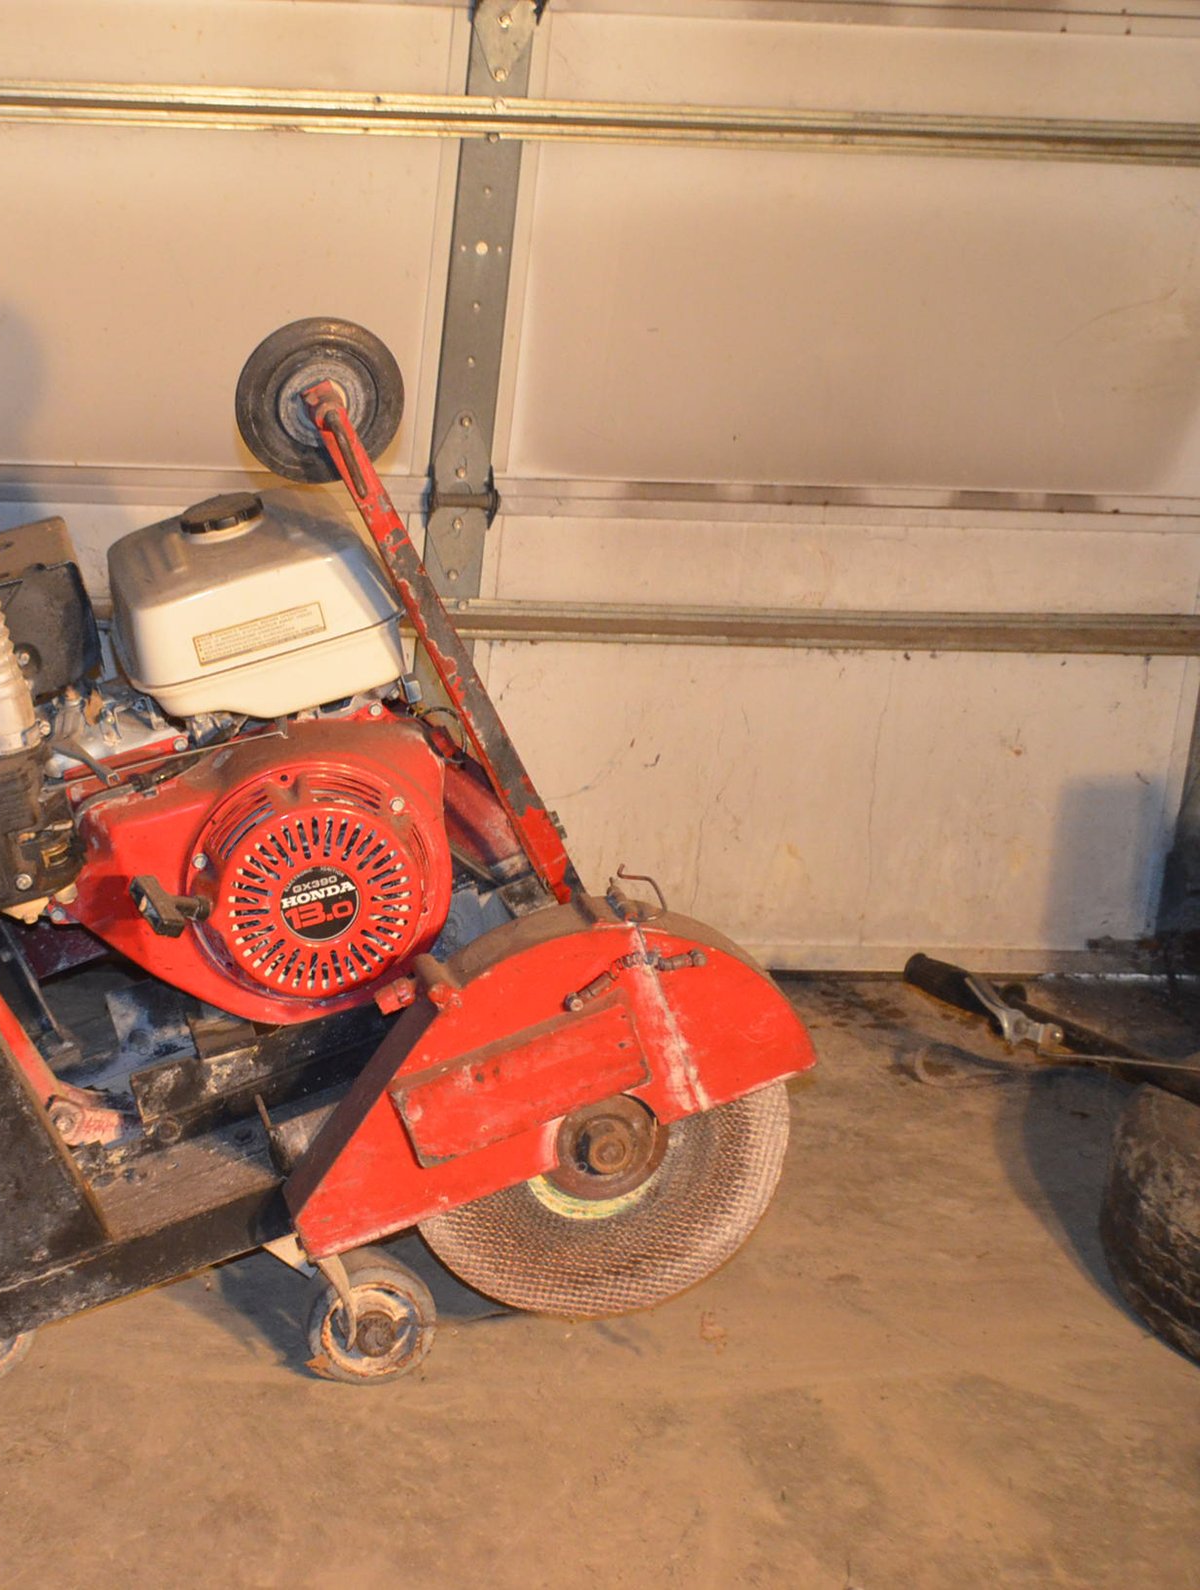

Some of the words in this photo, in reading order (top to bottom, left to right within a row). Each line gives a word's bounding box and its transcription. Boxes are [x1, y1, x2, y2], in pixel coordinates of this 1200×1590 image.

[280, 881, 356, 909] HONDA
[292, 875, 338, 894] GX390
[284, 900, 354, 929] 13.0
